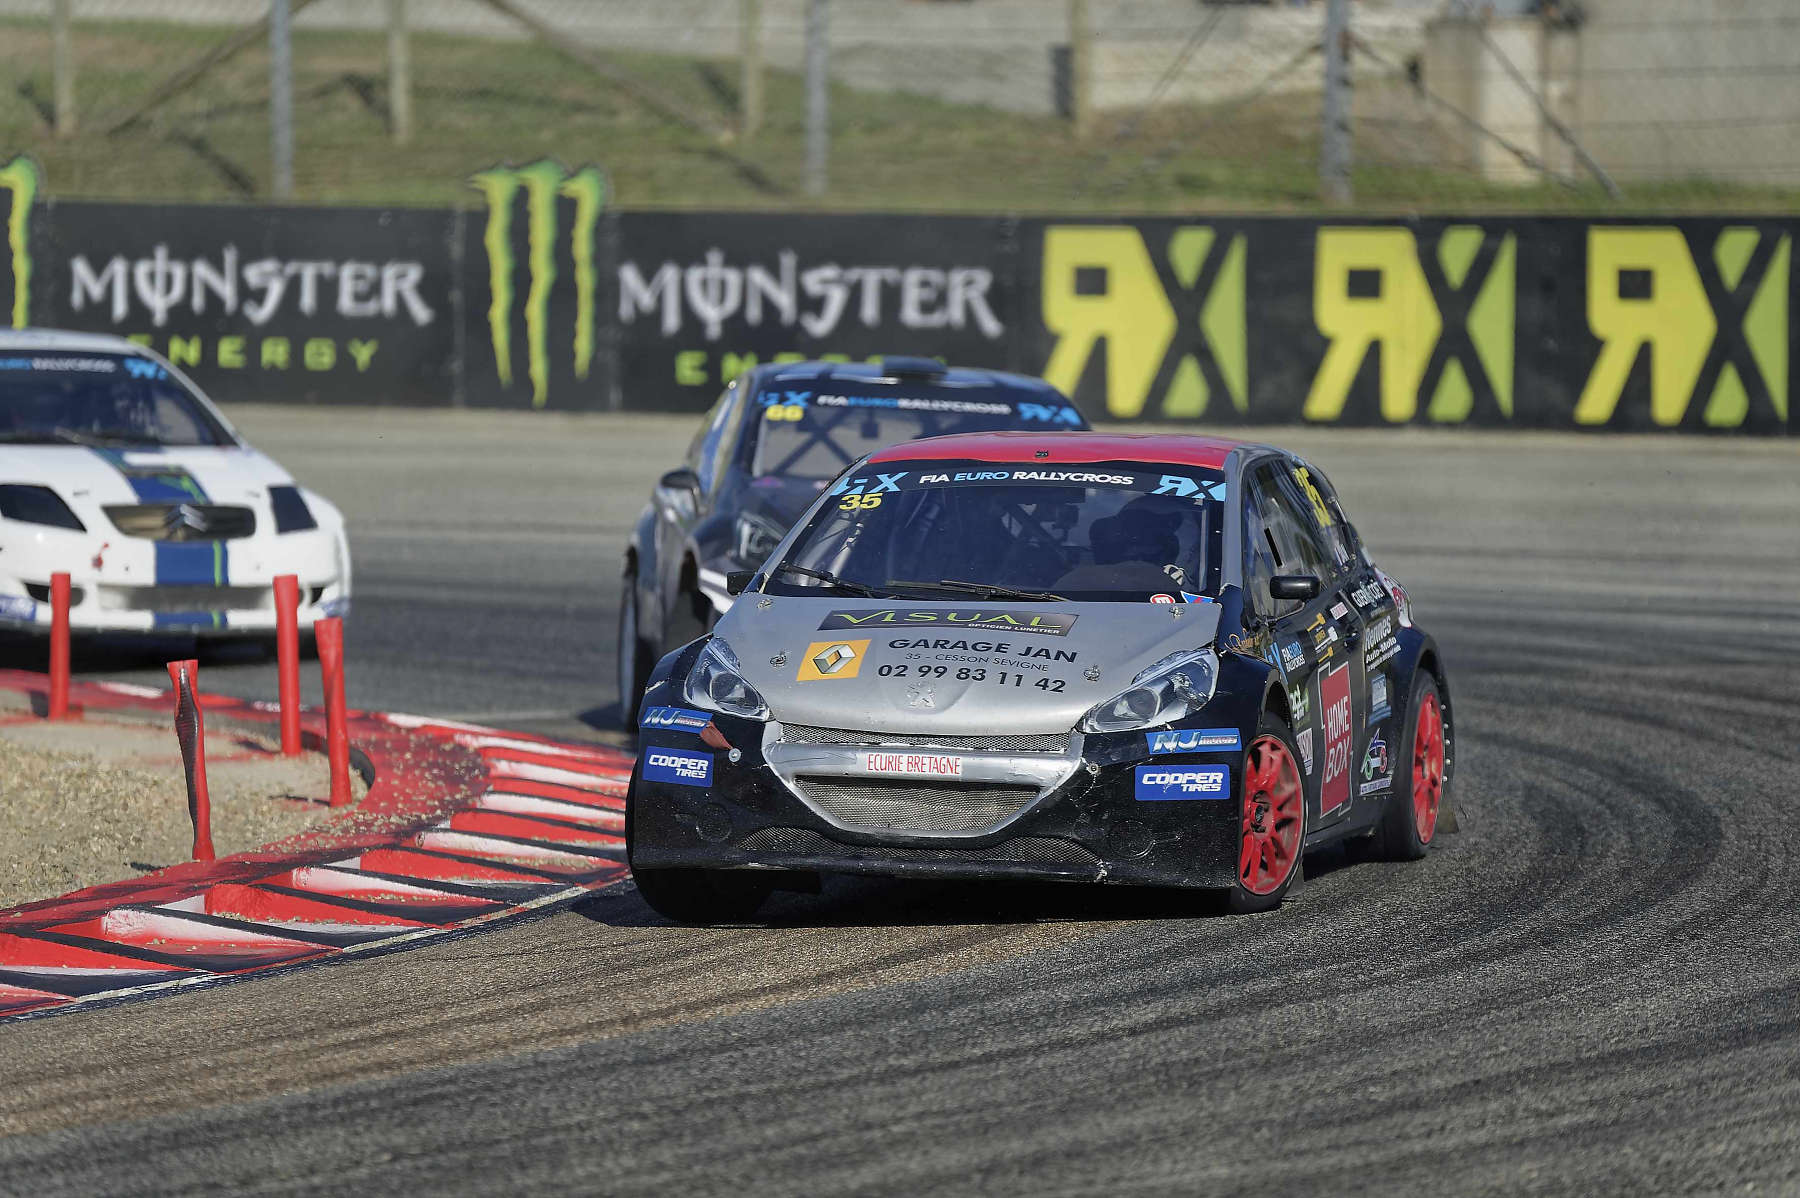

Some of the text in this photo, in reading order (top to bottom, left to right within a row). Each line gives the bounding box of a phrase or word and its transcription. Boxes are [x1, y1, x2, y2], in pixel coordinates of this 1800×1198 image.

[69, 243, 435, 327] MONSTER
[617, 245, 1004, 341] MONSTER
[919, 471, 1135, 485] FIA EURO RALLYCROSS
[838, 492, 884, 510] 35
[833, 610, 1062, 629] VISUAL
[1014, 626, 1060, 634] LUNETIER
[888, 638, 1078, 664] GARAGE JAN
[905, 652, 922, 661] 35
[935, 653, 990, 664] CESSON
[992, 657, 1049, 672] SEVIGNE
[878, 664, 1067, 693] 02 99 83 11 42
[643, 708, 681, 725] NJ
[1327, 695, 1350, 743] HOME
[1152, 731, 1201, 752] NJ
[648, 754, 709, 770] COOPER
[867, 753, 961, 775] ECURIE BRETAGNE
[1325, 735, 1350, 783] BOX
[675, 768, 707, 779] TIRES
[1142, 772, 1224, 785] COOPER
[1180, 783, 1223, 792] TIRES
